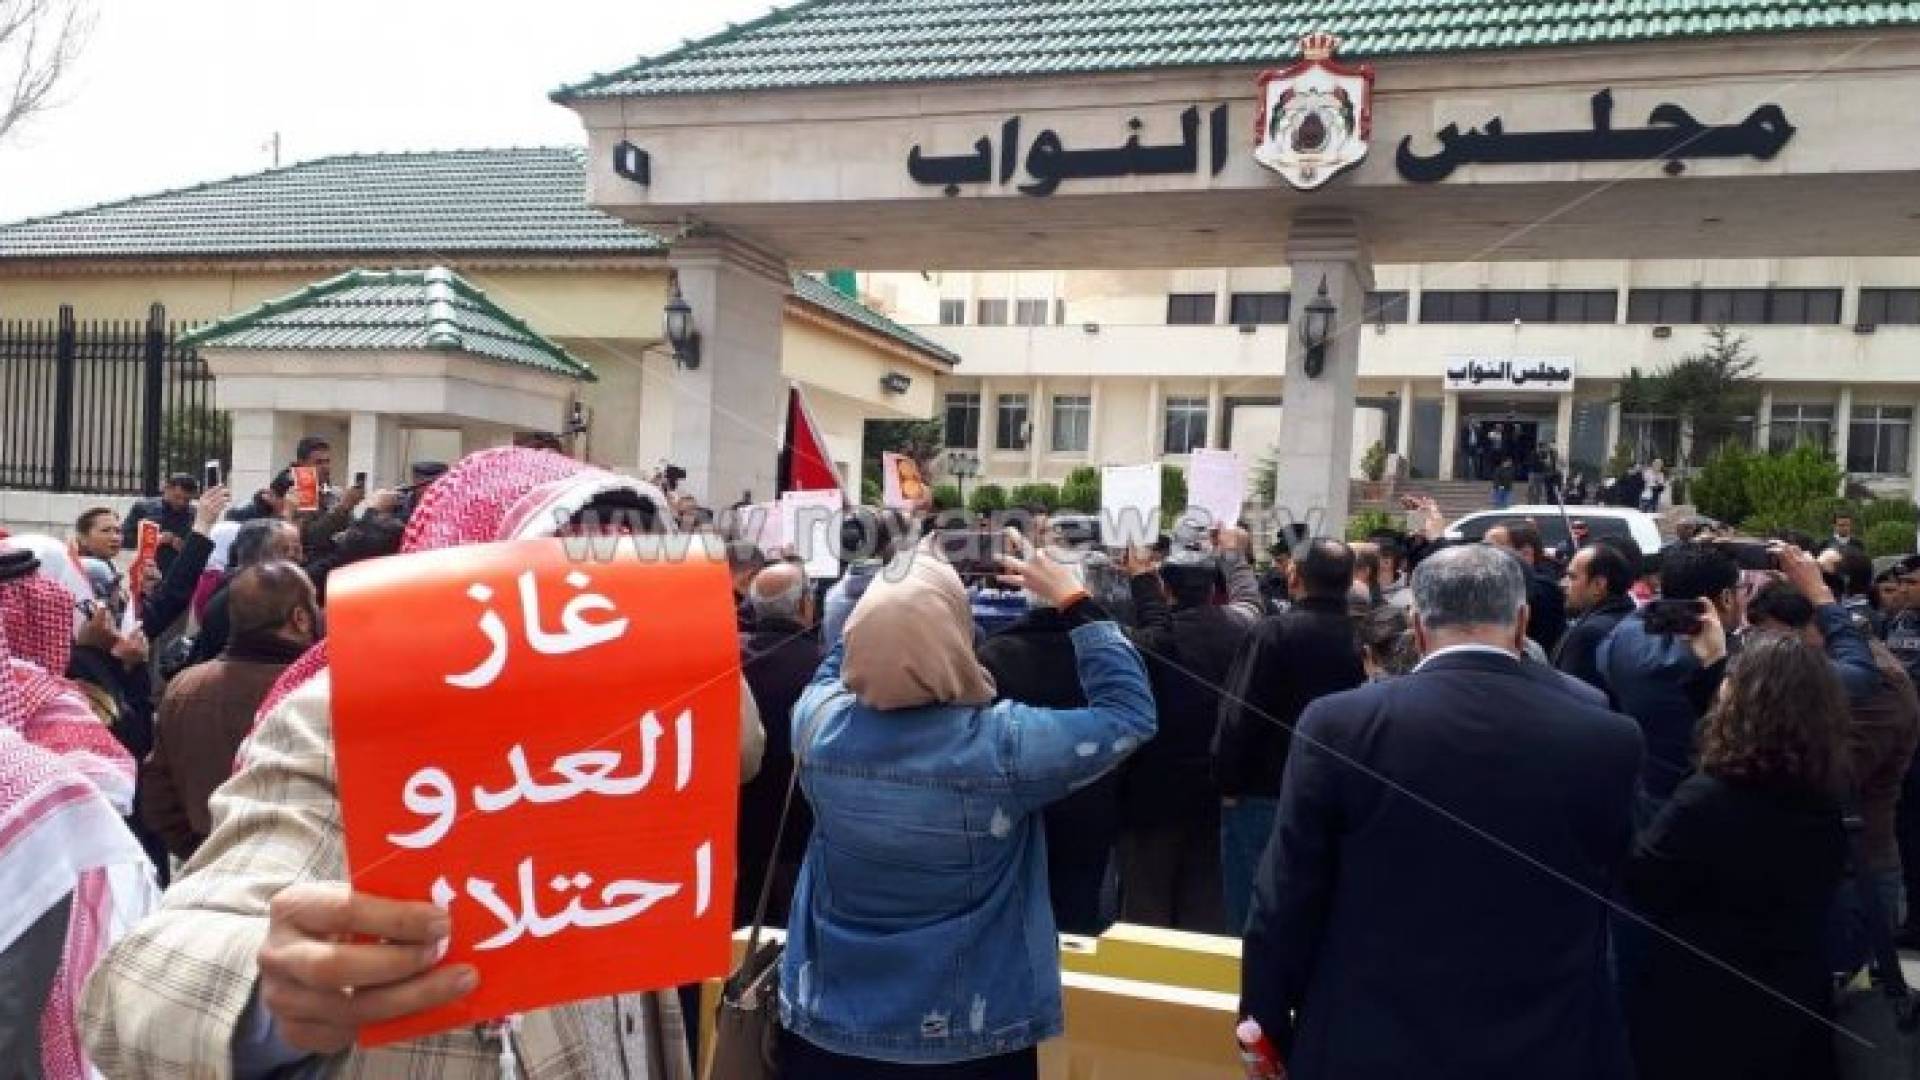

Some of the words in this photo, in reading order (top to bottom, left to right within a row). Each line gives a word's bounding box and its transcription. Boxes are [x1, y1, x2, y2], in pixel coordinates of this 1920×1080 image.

[907, 103, 1229, 199] النواب
[1396, 88, 1797, 182] مجلس
[1446, 360, 1512, 386] النواب
[1512, 361, 1571, 386] مجلس
[445, 566, 630, 689] غاز
[387, 709, 694, 850] العدو
